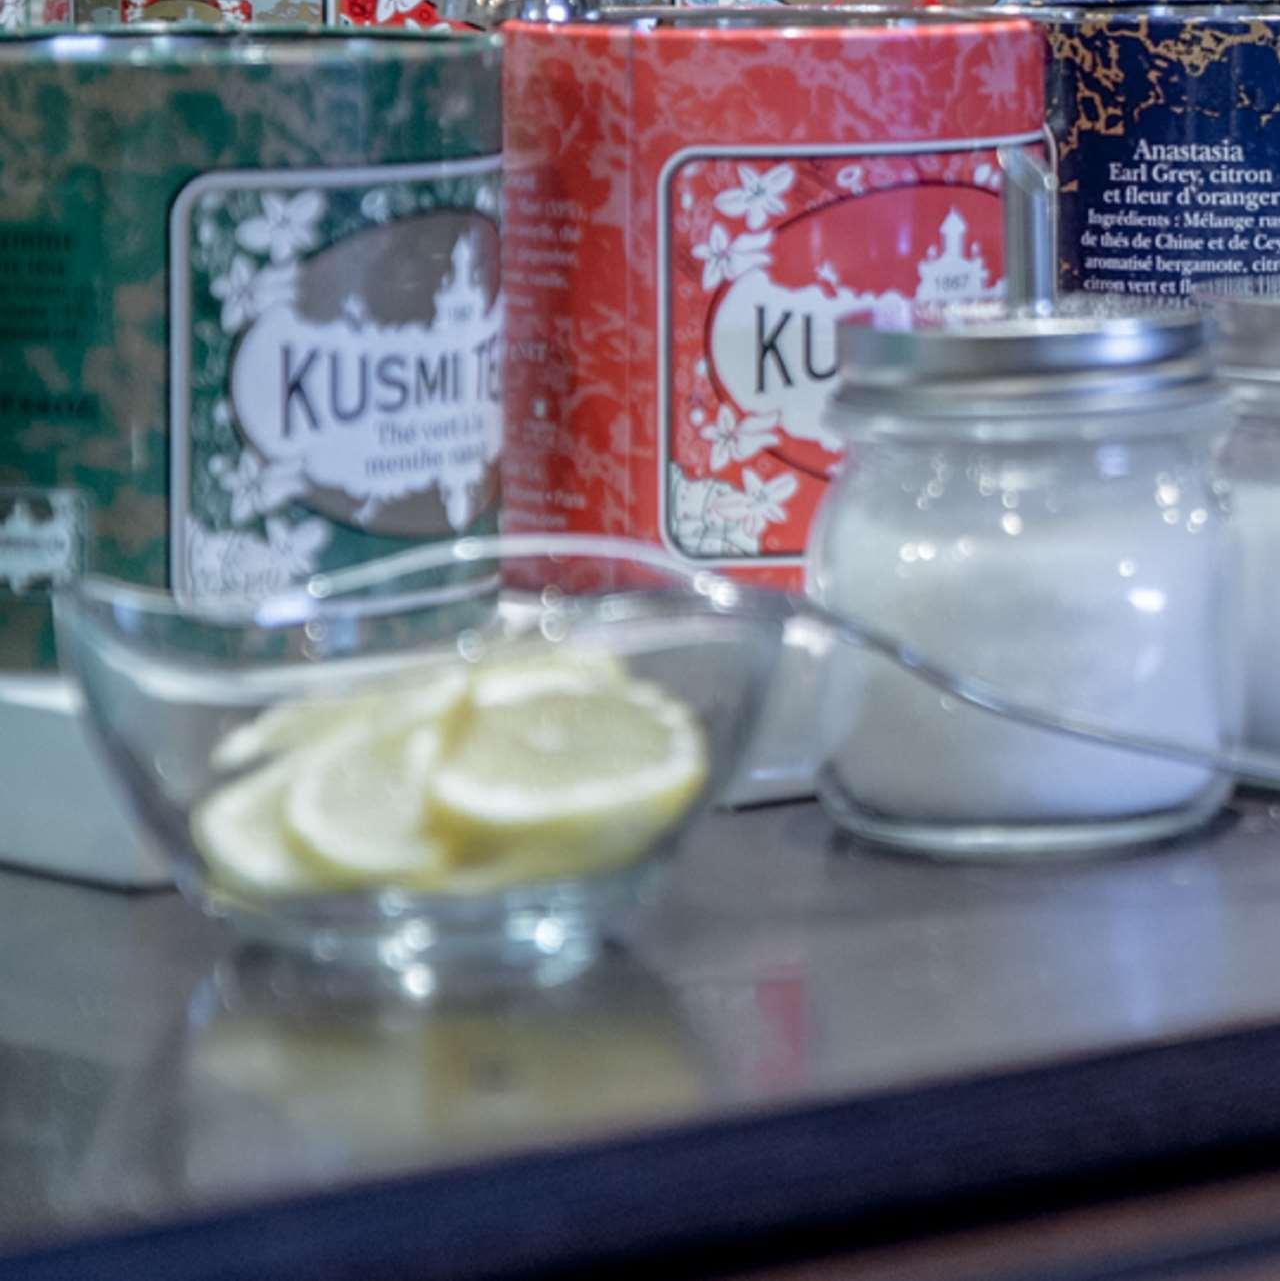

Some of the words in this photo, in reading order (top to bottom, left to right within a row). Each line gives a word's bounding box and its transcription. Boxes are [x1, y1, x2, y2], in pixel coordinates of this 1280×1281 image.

[1133, 138, 1245, 163] Anastasia
[1108, 163, 1148, 183] Earl
[1152, 163, 1205, 189] Grey,
[1209, 164, 1273, 184] citron
[1102, 188, 1121, 204] et
[1125, 185, 1173, 204] fleur
[1183, 210, 1255, 232] Mélange
[1080, 231, 1098, 248] de
[1131, 232, 1152, 250] de
[1155, 232, 1204, 251] Chine
[1207, 235, 1225, 251] et
[1228, 235, 1250, 251] de
[1083, 275, 1126, 292] citron
[1127, 280, 1156, 295] vert
[1159, 279, 1178, 295] et
[280, 343, 461, 438] KUSMI
